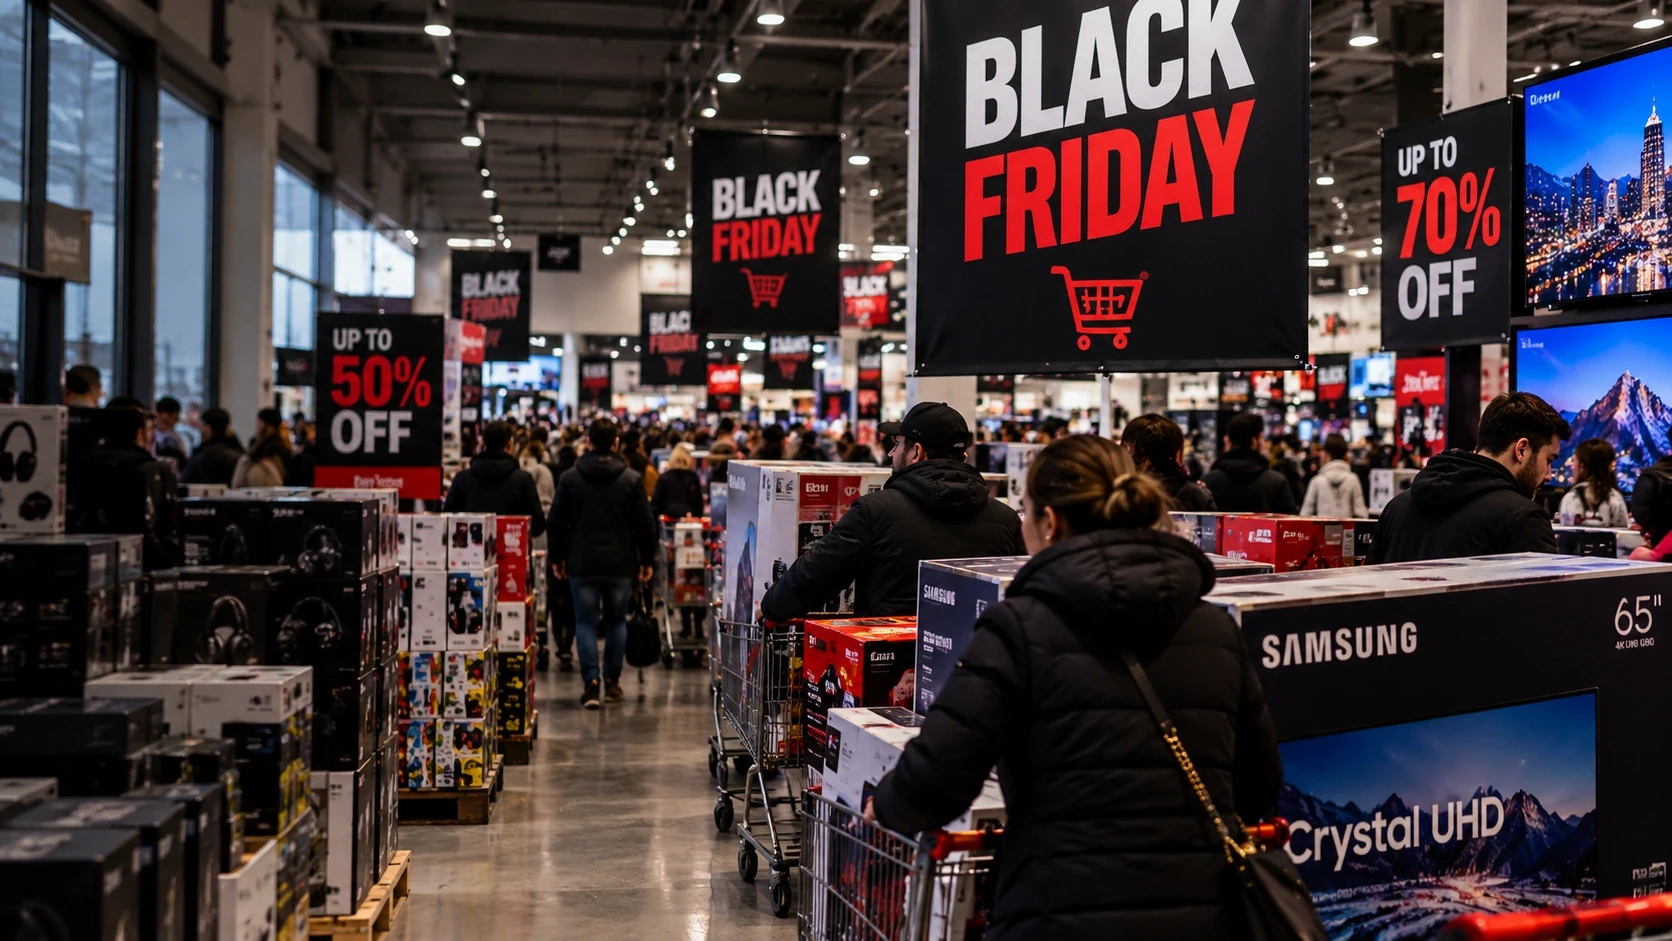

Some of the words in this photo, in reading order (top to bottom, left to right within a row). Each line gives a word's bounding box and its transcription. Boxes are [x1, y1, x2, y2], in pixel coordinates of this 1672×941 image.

[965, 0, 1255, 149] BLACK
[964, 99, 1256, 262] FRIDAY
[1398, 144, 1426, 177] UP
[1430, 135, 1458, 170] TO
[712, 169, 822, 220] BLACK
[1397, 167, 1501, 259] 70%
[711, 213, 822, 263] FRIDAY
[461, 294, 520, 321] FRIDAY
[462, 269, 520, 298] BLACK
[1398, 257, 1477, 321] OFF
[332, 327, 361, 351] UP
[365, 327, 393, 351] TO
[649, 310, 692, 335] BLAC
[331, 354, 432, 408] 50%
[331, 409, 413, 454] OFF
[1262, 621, 1418, 669] SAMSUNG
[1285, 804, 1420, 872] Crystal
[1432, 796, 1505, 844] UHD
